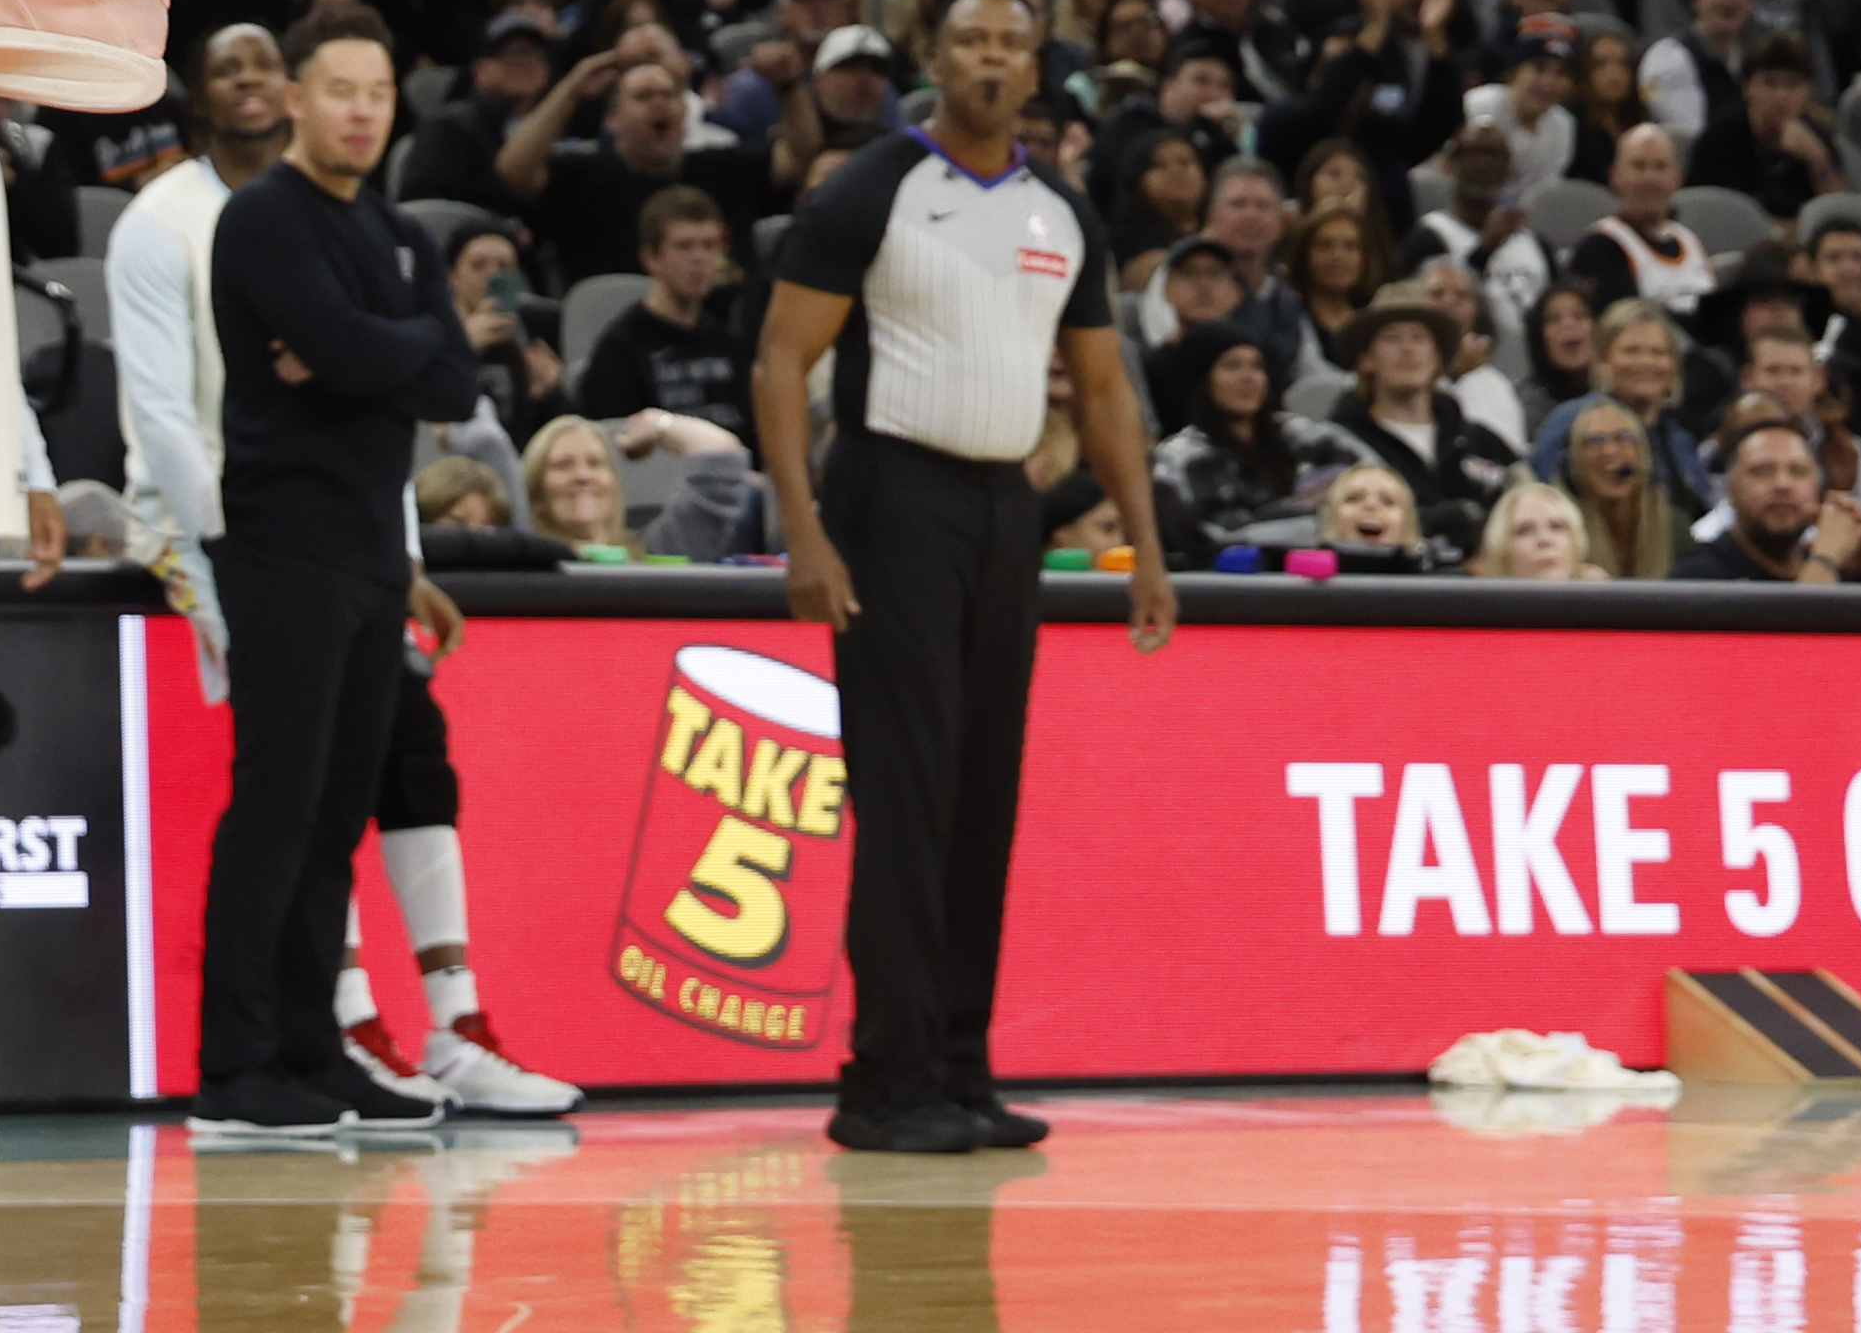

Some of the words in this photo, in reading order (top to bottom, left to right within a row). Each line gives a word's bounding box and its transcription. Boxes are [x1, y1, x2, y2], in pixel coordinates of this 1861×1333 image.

[660, 686, 848, 837] TAKE
[664, 815, 791, 961] 5
[1287, 763, 1679, 935] TAKE
[1721, 770, 1800, 936] 5
[619, 946, 666, 1000] OIL
[679, 977, 805, 1041] CHANGE
